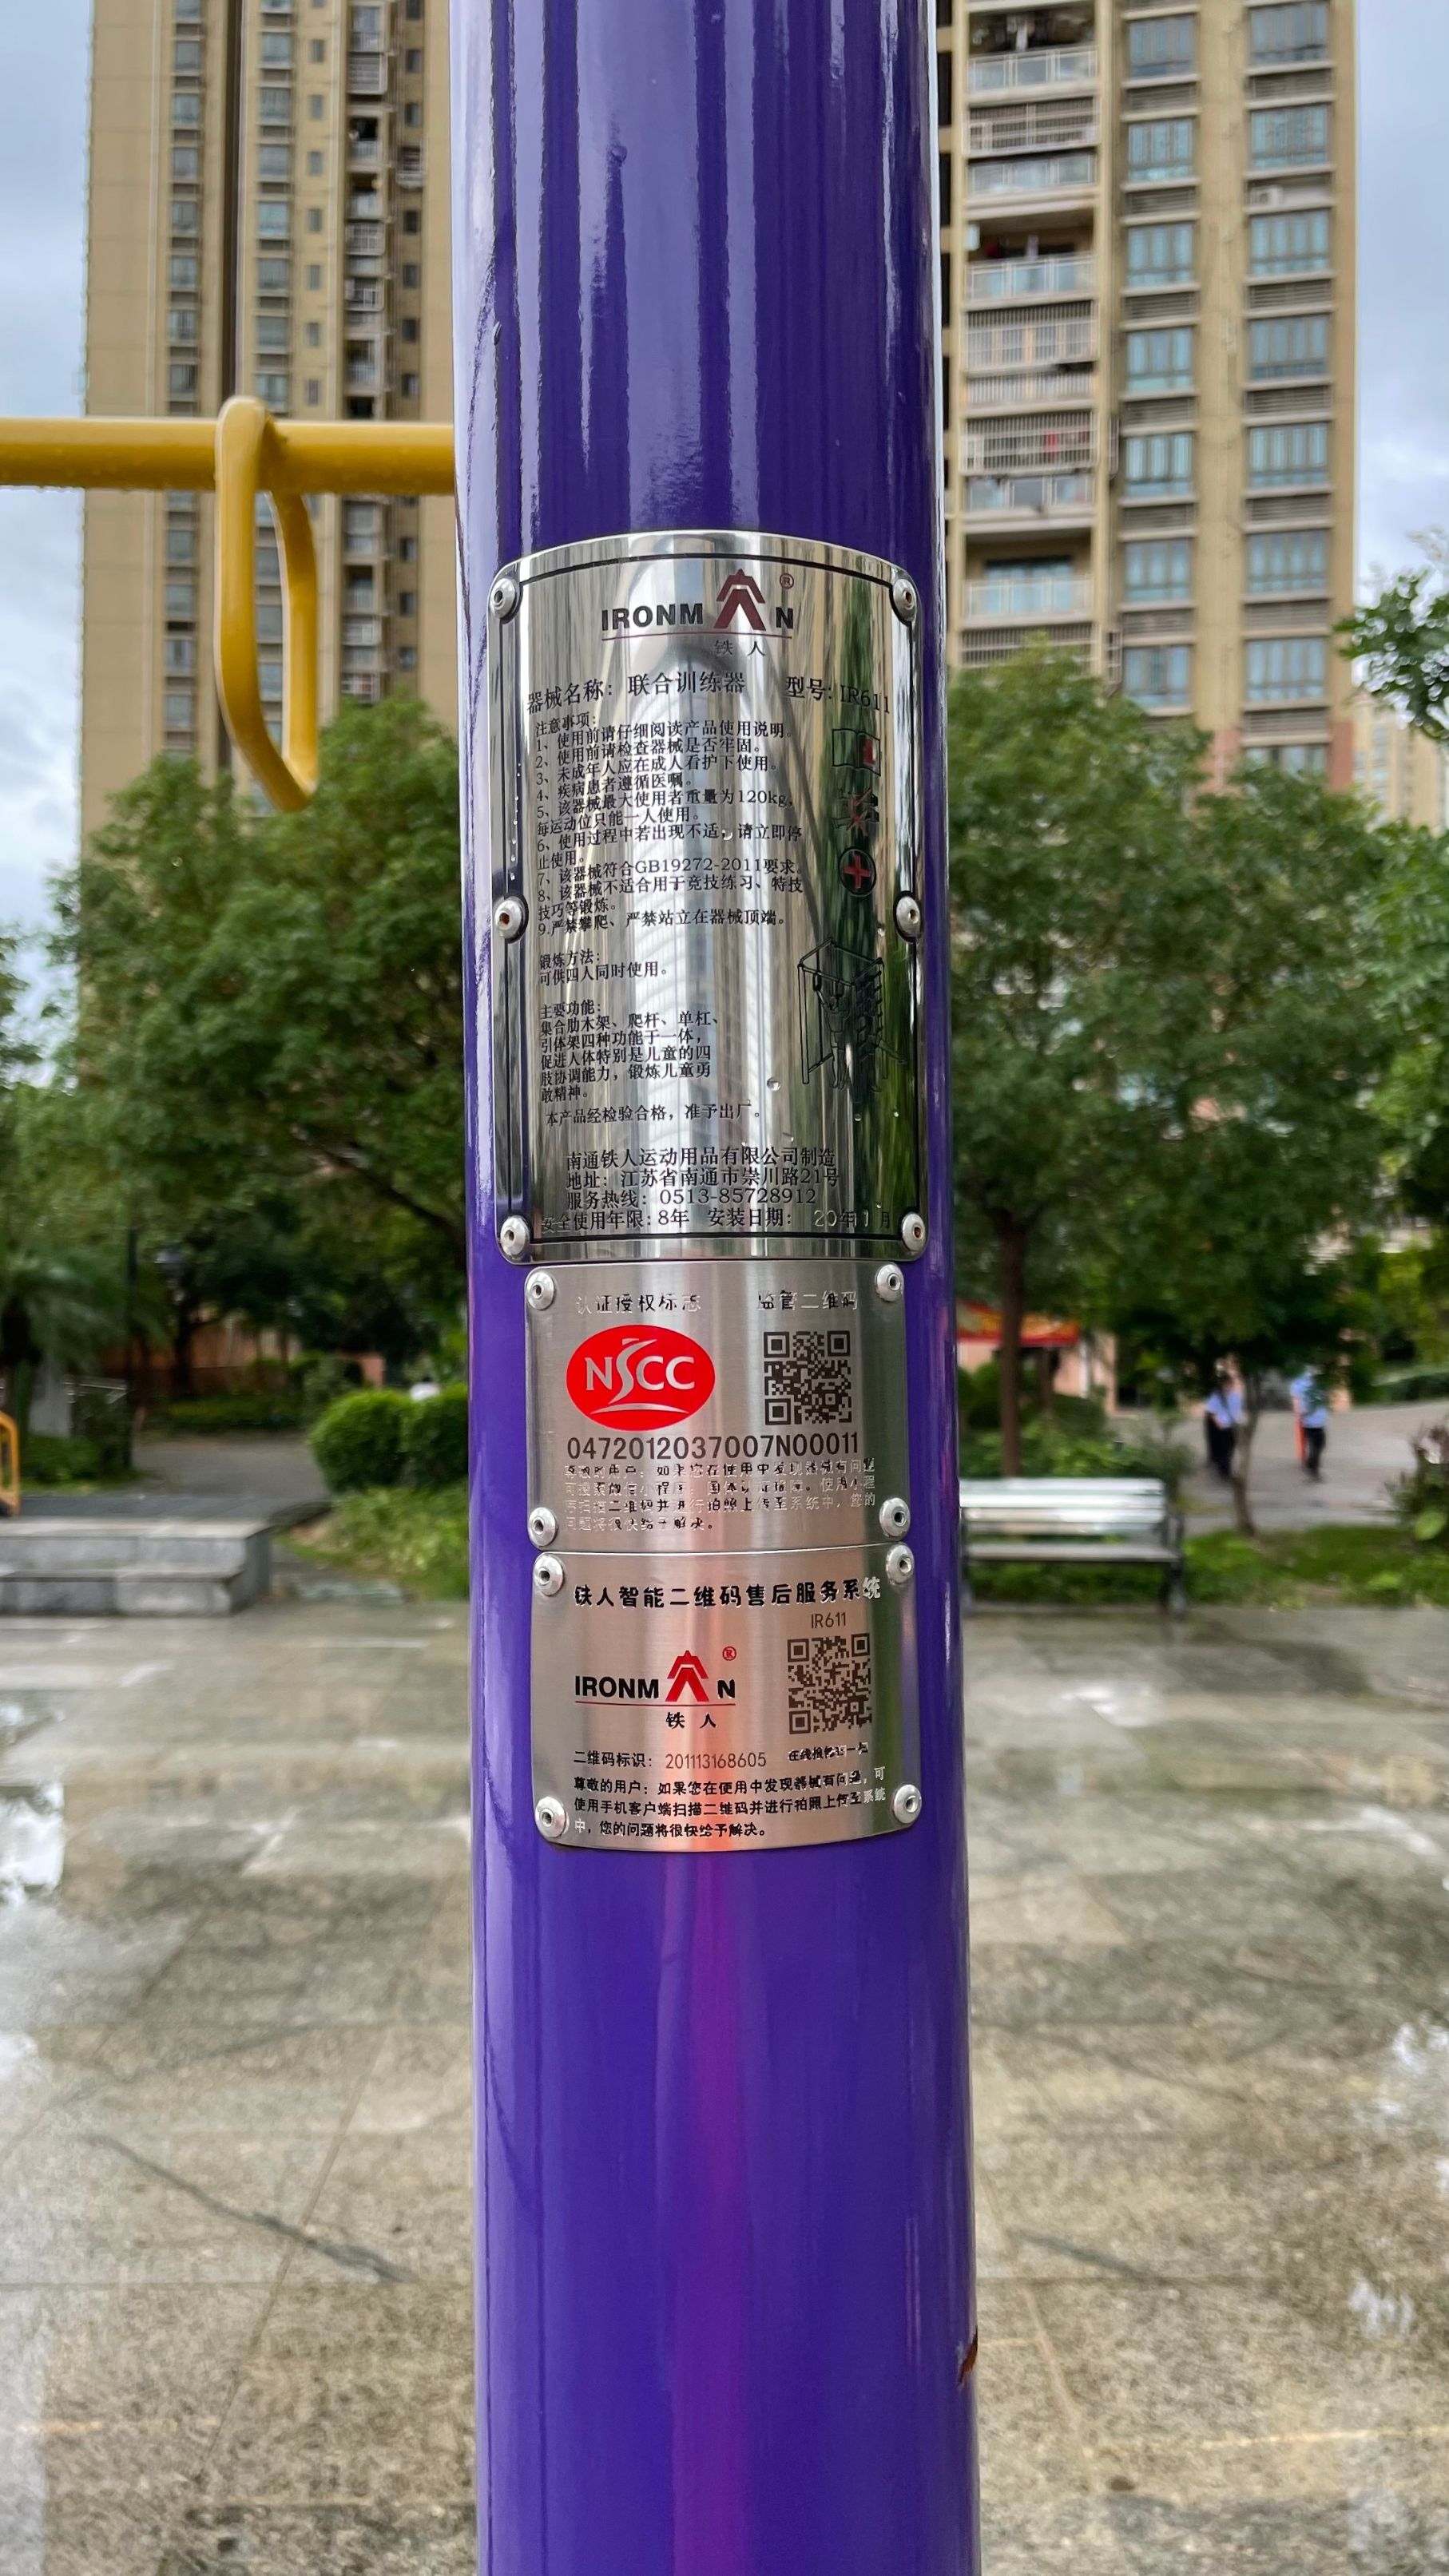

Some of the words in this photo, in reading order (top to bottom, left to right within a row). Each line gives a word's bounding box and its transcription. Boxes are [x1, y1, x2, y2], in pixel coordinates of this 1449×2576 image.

[584, 1337, 696, 1405] NSCC
[566, 1431, 859, 1460] 0472012037007N00011
[574, 1576, 881, 1608] 铁人智能二维码售后服务系统
[810, 1611, 847, 1630] IR611
